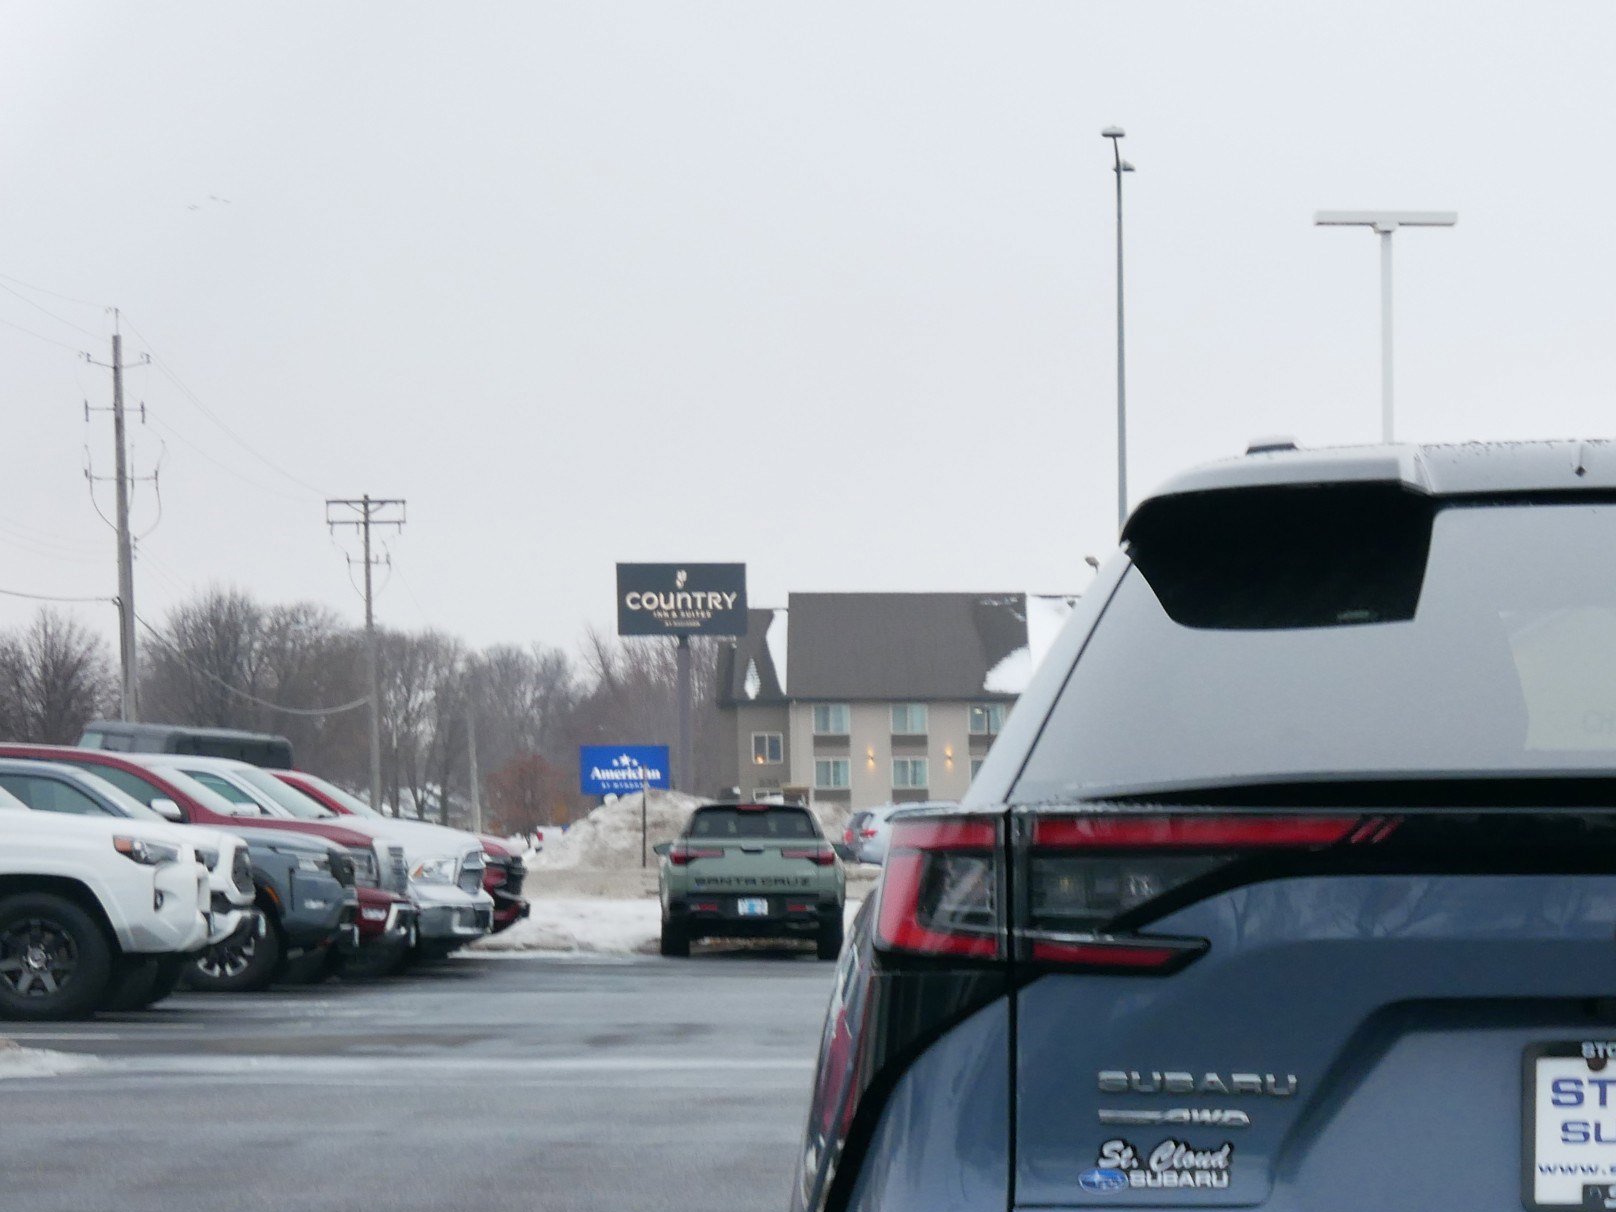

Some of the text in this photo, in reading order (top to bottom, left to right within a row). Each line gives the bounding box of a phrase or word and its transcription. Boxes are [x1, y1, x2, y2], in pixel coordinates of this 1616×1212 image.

[625, 591, 738, 611] COUNTRY
[1098, 1071, 1297, 1095] SUBARU
[1150, 1140, 1232, 1172] Cloud
[1129, 1170, 1229, 1188] SUBARU
